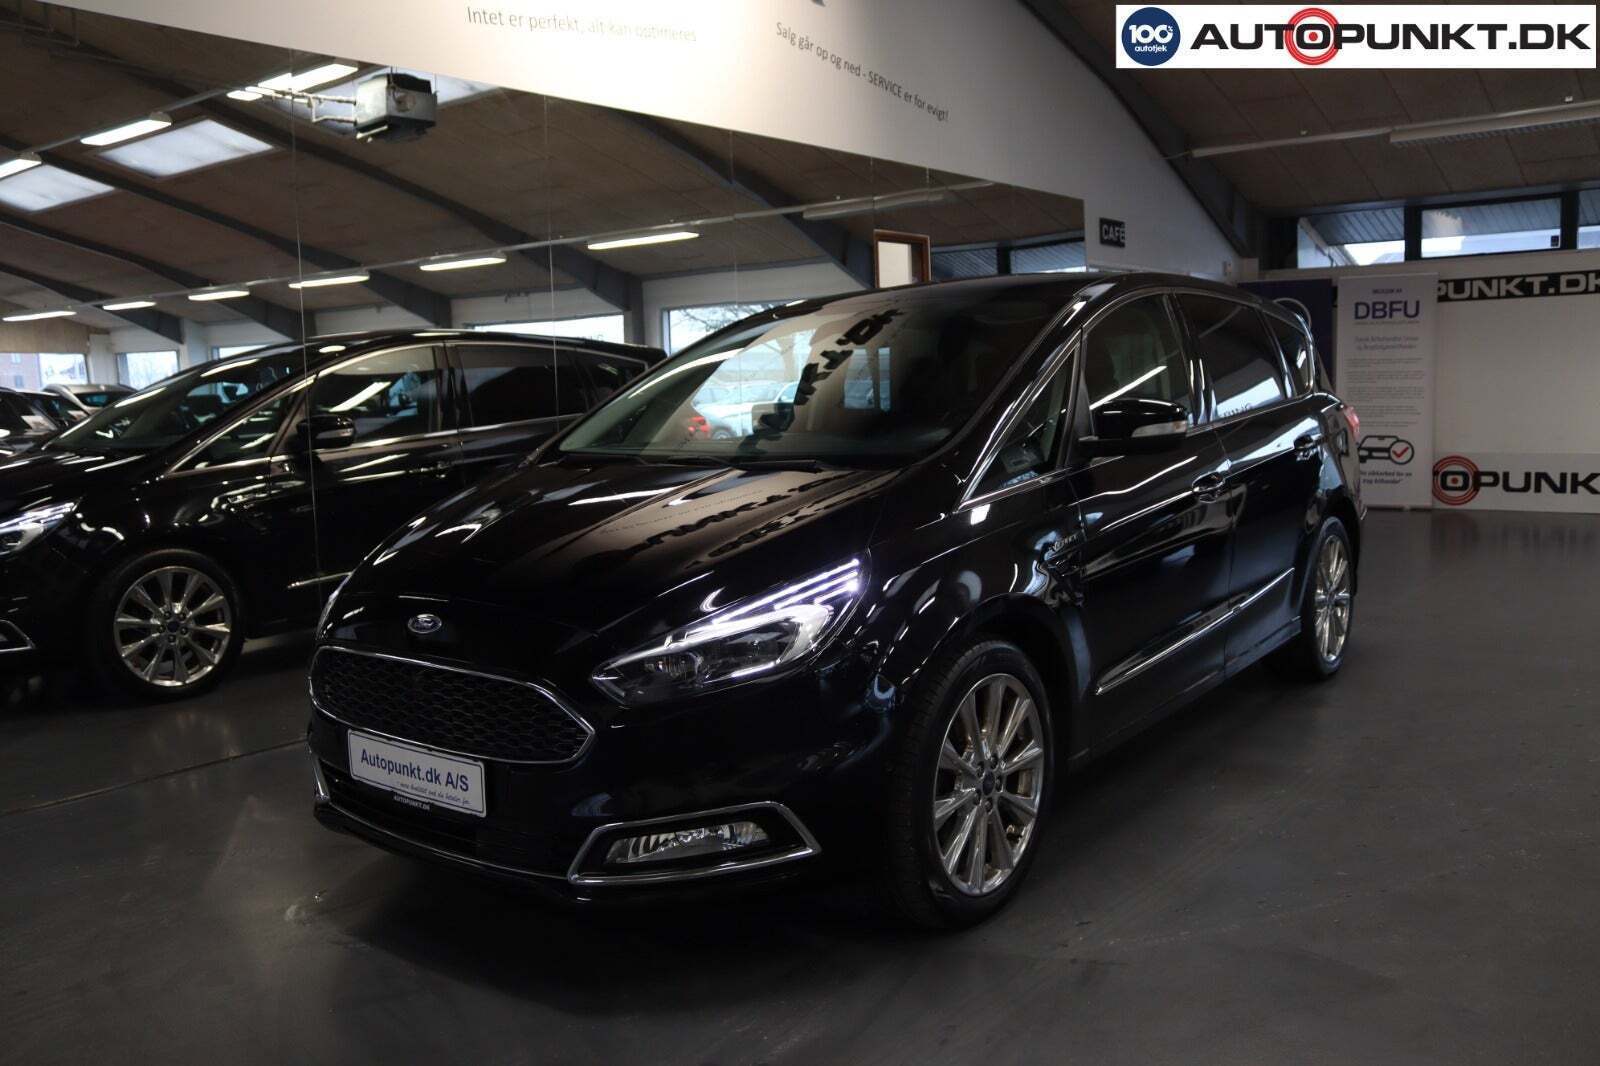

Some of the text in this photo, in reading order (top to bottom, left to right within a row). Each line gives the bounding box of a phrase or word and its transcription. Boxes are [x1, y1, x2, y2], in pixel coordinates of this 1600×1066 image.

[466, 6, 504, 26] Intet
[508, 13, 522, 27] er
[528, 15, 584, 34] perfekt,
[776, 22, 796, 46] Salg
[798, 36, 814, 52] går
[816, 46, 828, 60] op
[830, 54, 842, 70] og
[843, 60, 861, 77] ned
[868, 70, 902, 98] SERVICE
[904, 91, 912, 103] er
[914, 94, 926, 109] for
[927, 103, 949, 122] evigt!
[1102, 224, 1125, 242] CAFÉ
[1354, 299, 1420, 319] DBFU
[1433, 471, 1600, 495] OPUNK
[360, 747, 470, 793] Autopunkt.dk A/S
